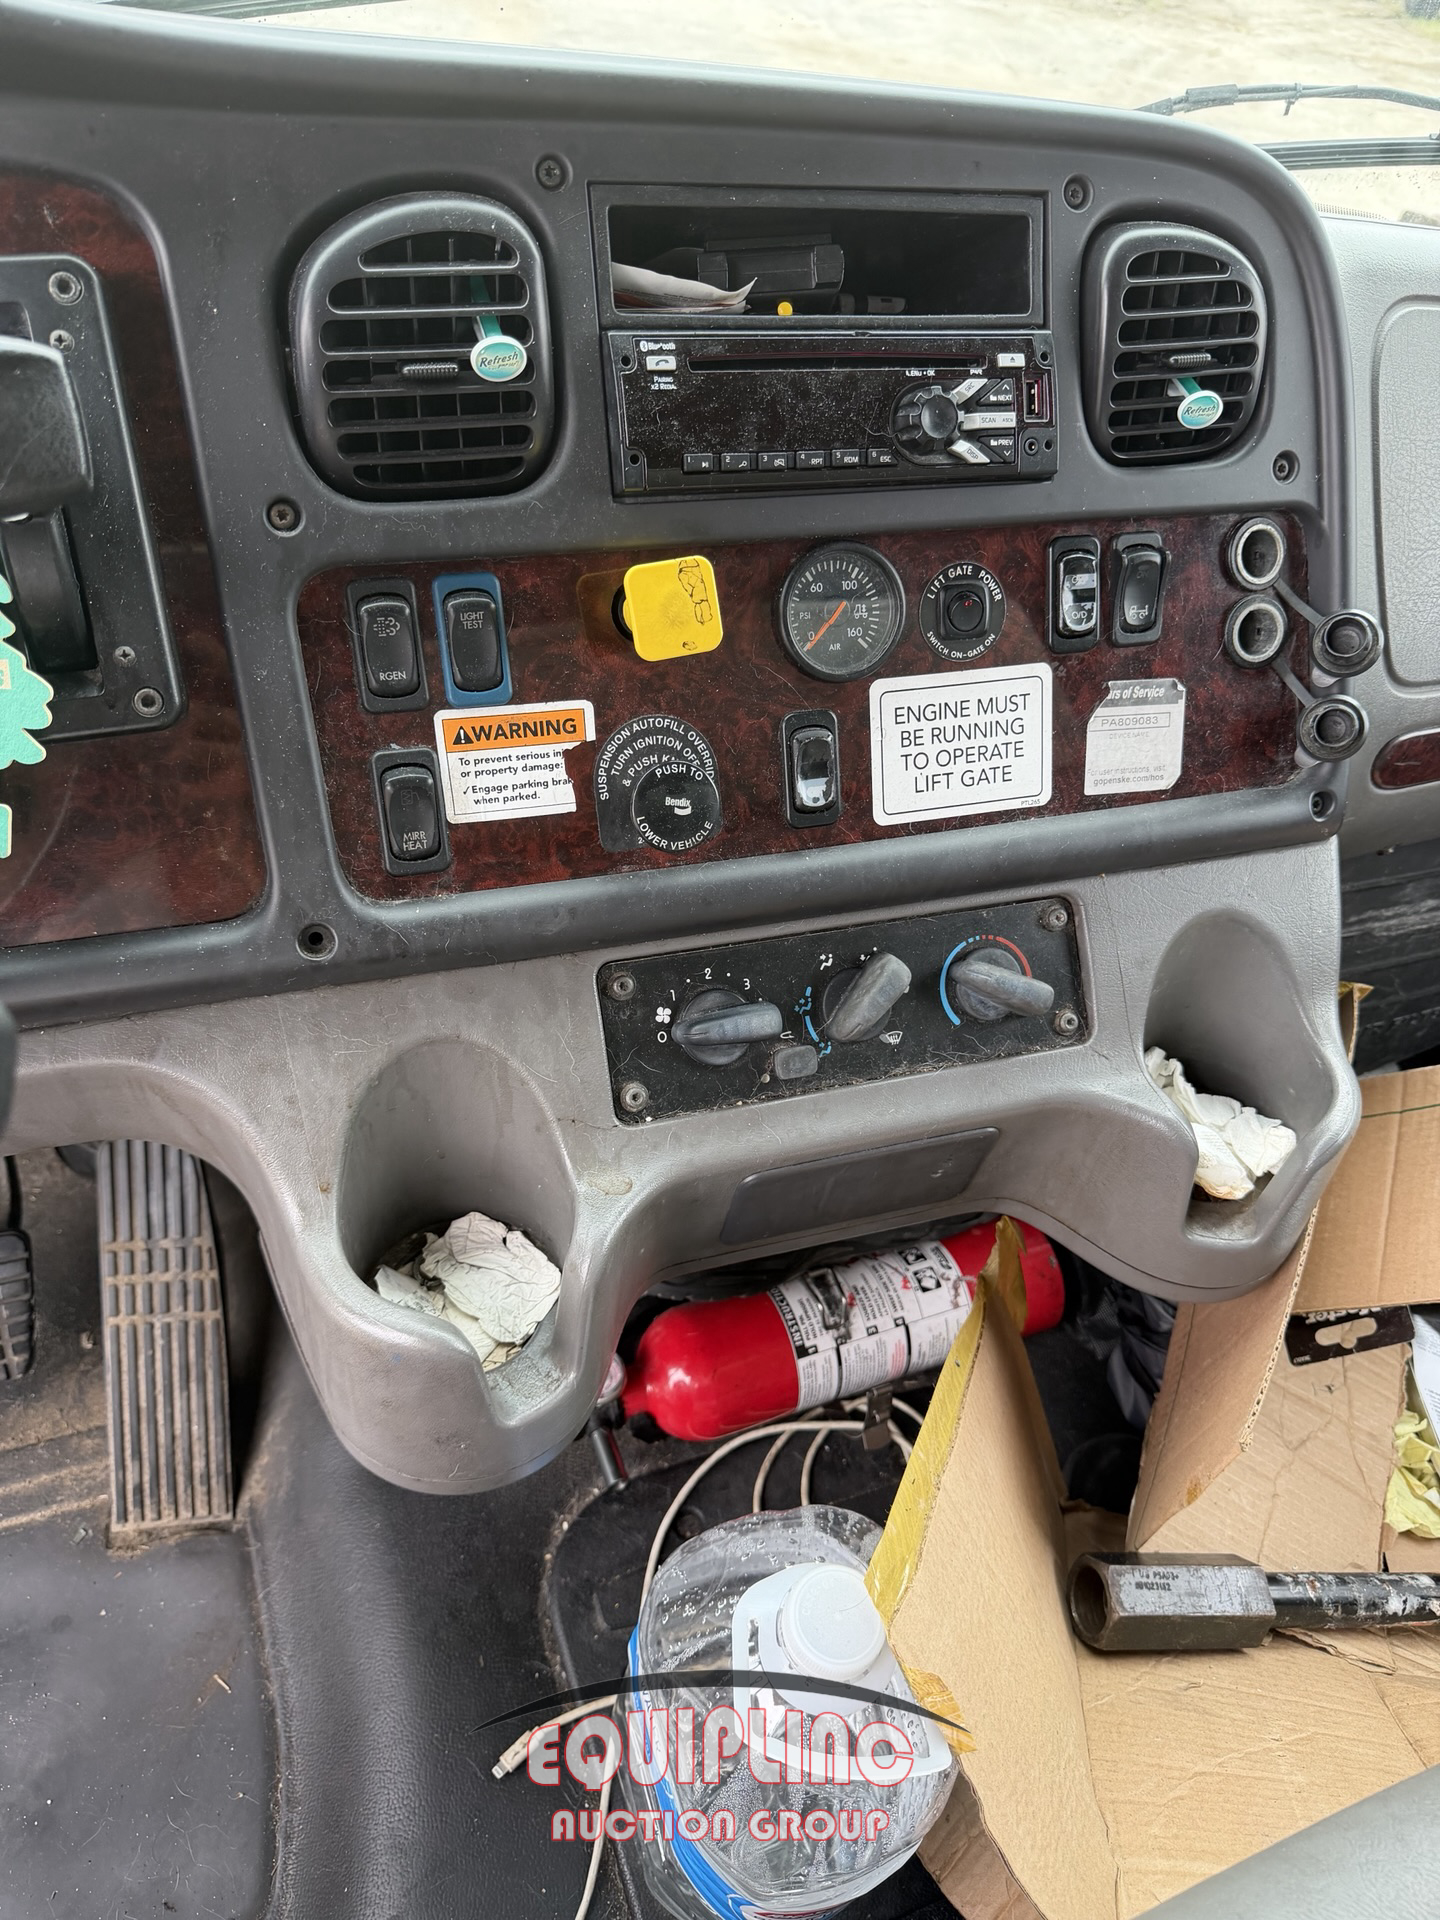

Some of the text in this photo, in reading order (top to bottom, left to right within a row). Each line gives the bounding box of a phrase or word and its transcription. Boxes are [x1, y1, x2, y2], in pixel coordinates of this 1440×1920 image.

[480, 351, 518, 368] Refresh
[1184, 404, 1217, 415] Refresh
[967, 448, 979, 460] DISP
[810, 583, 823, 592] 60
[842, 581, 858, 590] 100
[927, 565, 1002, 602] LIFT GATE POWER
[460, 611, 484, 621] LIGHT
[1071, 611, 1087, 619] O/D
[462, 620, 484, 630] TEST
[808, 632, 815, 640] 0
[847, 627, 863, 637] 160
[829, 643, 841, 651] AIR
[927, 631, 996, 659] SWITCH ON-GATE ON
[379, 671, 407, 681] RGEN
[1122, 686, 1133, 699] of
[1132, 685, 1165, 699] Service
[894, 693, 1031, 725] ENGINE MUST
[1101, 716, 1158, 727] PA809083
[471, 718, 577, 741] WARNING
[900, 717, 1025, 748] BE RUNNING
[459, 757, 471, 766] To
[474, 754, 512, 767] prevent
[516, 751, 550, 761] serious
[597, 718, 715, 801] SUSPENSION AUTOFILL OVERRID
[611, 747, 634, 777] TURN
[633, 736, 683, 751] IGNITION
[901, 740, 1025, 771] TO OPERATE
[461, 762, 563, 778] or property damage:
[622, 754, 658, 787] & PUSH
[655, 764, 704, 781] PUSH TO
[914, 765, 1013, 793] LIFT GATE
[1093, 774, 1165, 787] gopenske.com/hos
[472, 784, 508, 795] Engage
[512, 778, 548, 792] parking
[474, 791, 540, 805] when parked.
[665, 796, 691, 808] Bendix
[403, 830, 426, 841] MIRR
[637, 816, 714, 851] LOWER VEHICLE
[403, 839, 428, 852] HEAT
[704, 967, 713, 980] 2
[743, 978, 751, 991] 3
[670, 989, 676, 1001] 1
